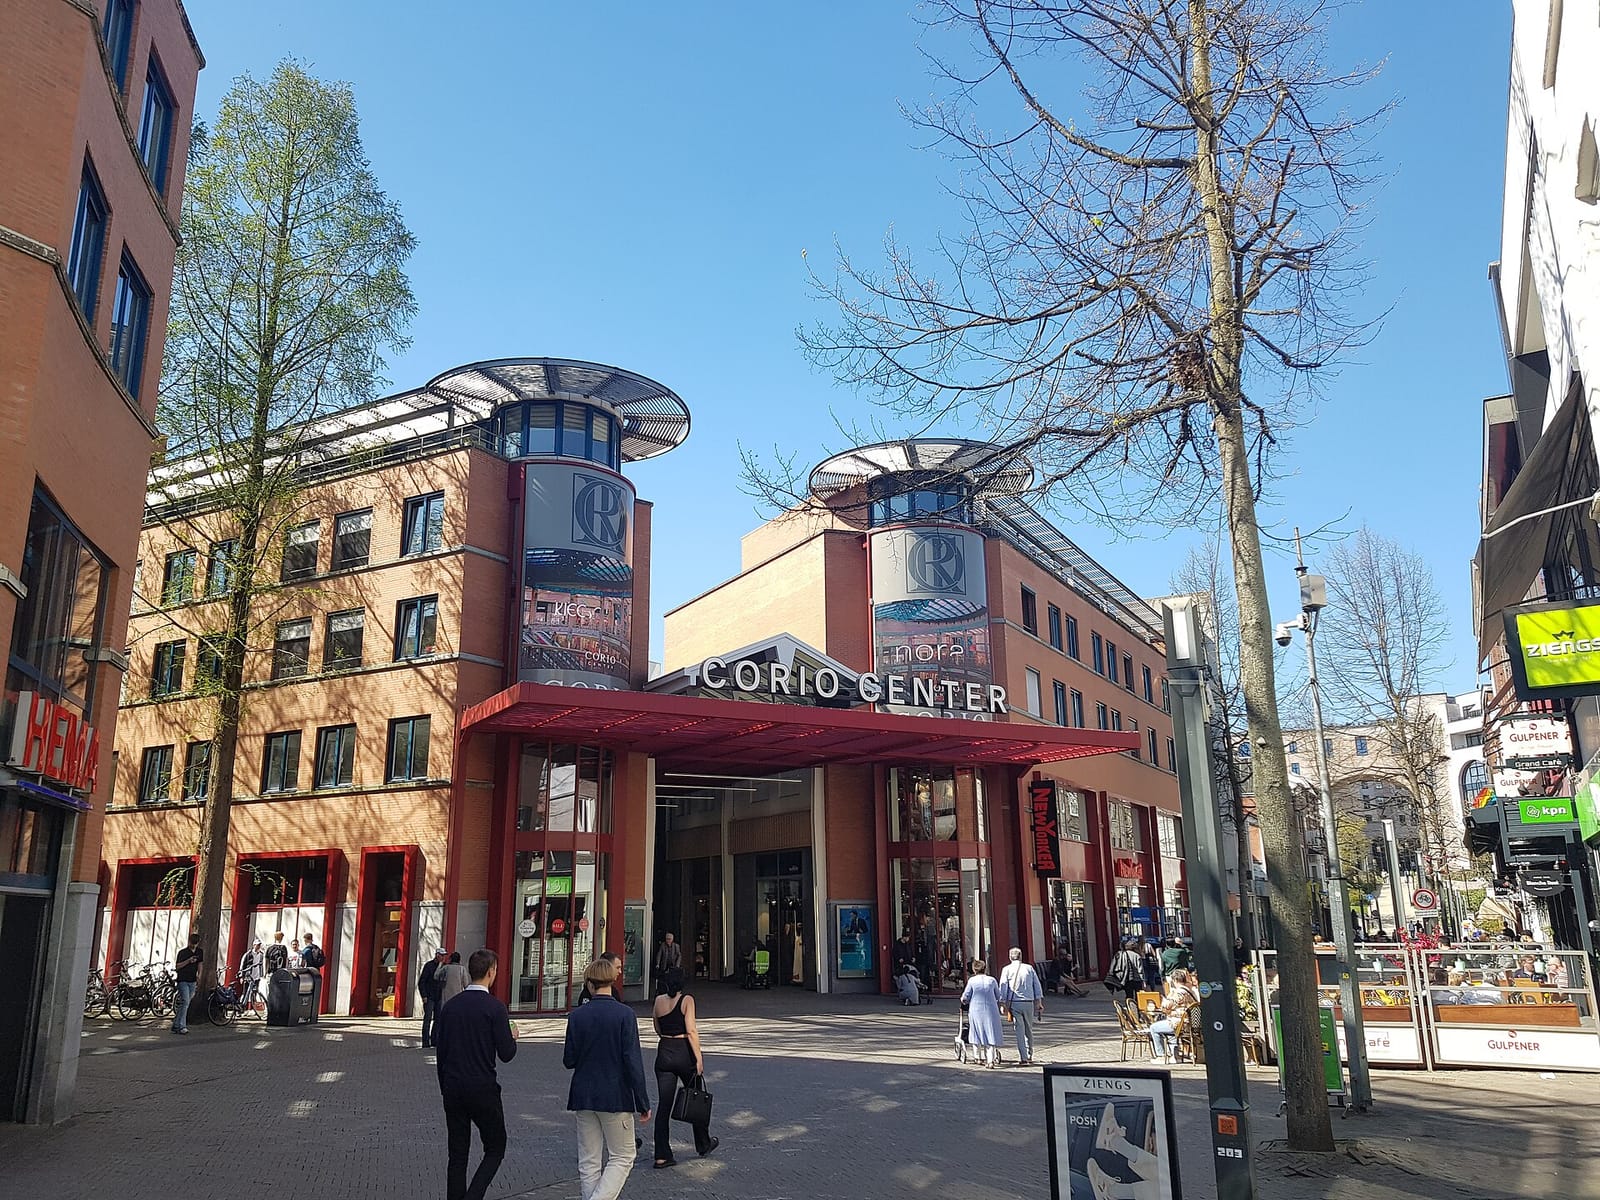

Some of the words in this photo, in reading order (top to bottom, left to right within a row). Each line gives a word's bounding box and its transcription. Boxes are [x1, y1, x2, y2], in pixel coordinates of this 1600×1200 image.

[896, 643, 964, 662] nora
[1525, 637, 1600, 658] ZIENGS
[585, 650, 616, 665] CORIO
[702, 656, 839, 698] CORIO
[858, 672, 1008, 713] CENTER
[22, 690, 100, 794] HEMA
[1509, 731, 1559, 742] GULPENER
[1500, 778, 1537, 787] GULPENER
[1542, 806, 1567, 816] kpn
[1487, 1039, 1540, 1051] GULPENER
[1083, 1078, 1132, 1091] ZIENGS
[1069, 1115, 1097, 1127] POSH
[1217, 1146, 1243, 1159] 203
